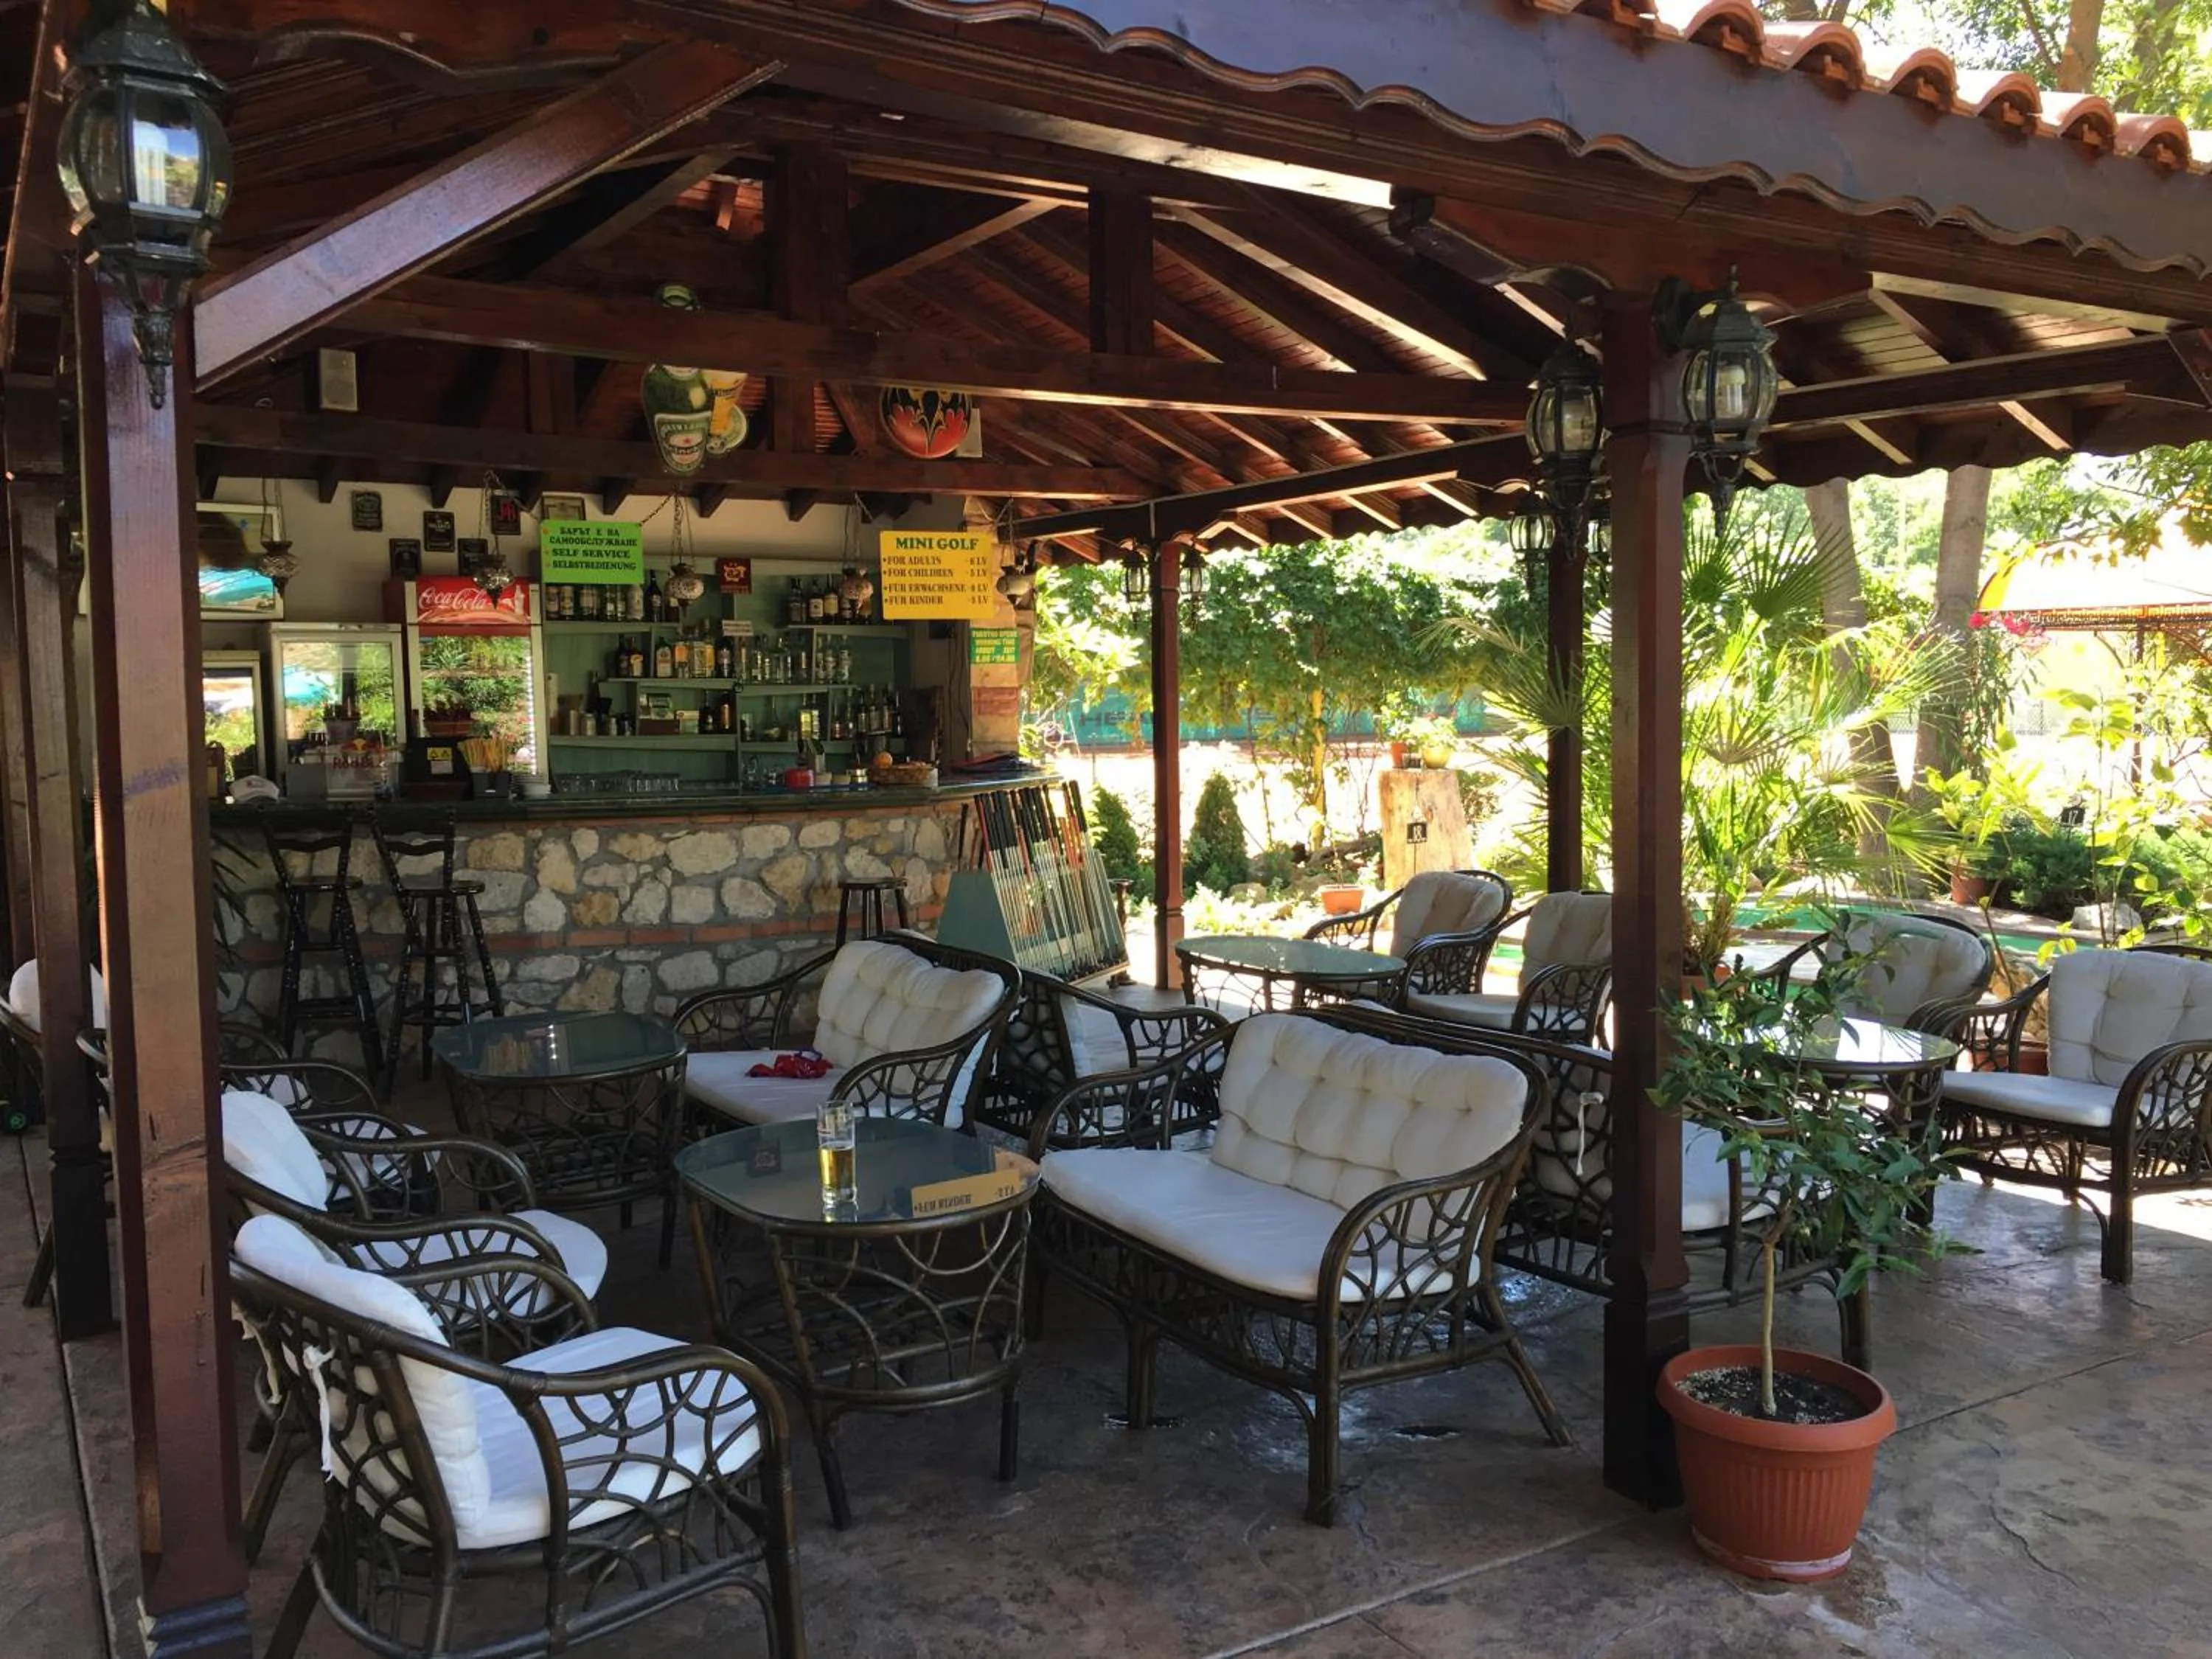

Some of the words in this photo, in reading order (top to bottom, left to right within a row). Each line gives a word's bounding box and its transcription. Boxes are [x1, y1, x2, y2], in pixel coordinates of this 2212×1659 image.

[896, 537, 933, 549] MINI
[937, 538, 979, 550] GOLF
[552, 548, 579, 557] SELF
[582, 549, 630, 558] SERVICE
[552, 560, 636, 570] SELBSTBEDIENUNG
[887, 556, 906, 566] FOR
[908, 556, 942, 566] ADULTS
[888, 568, 906, 577] FOR
[908, 568, 953, 577] CHILDREN
[908, 595, 944, 605] KINDER
[2067, 810, 2079, 826] 17
